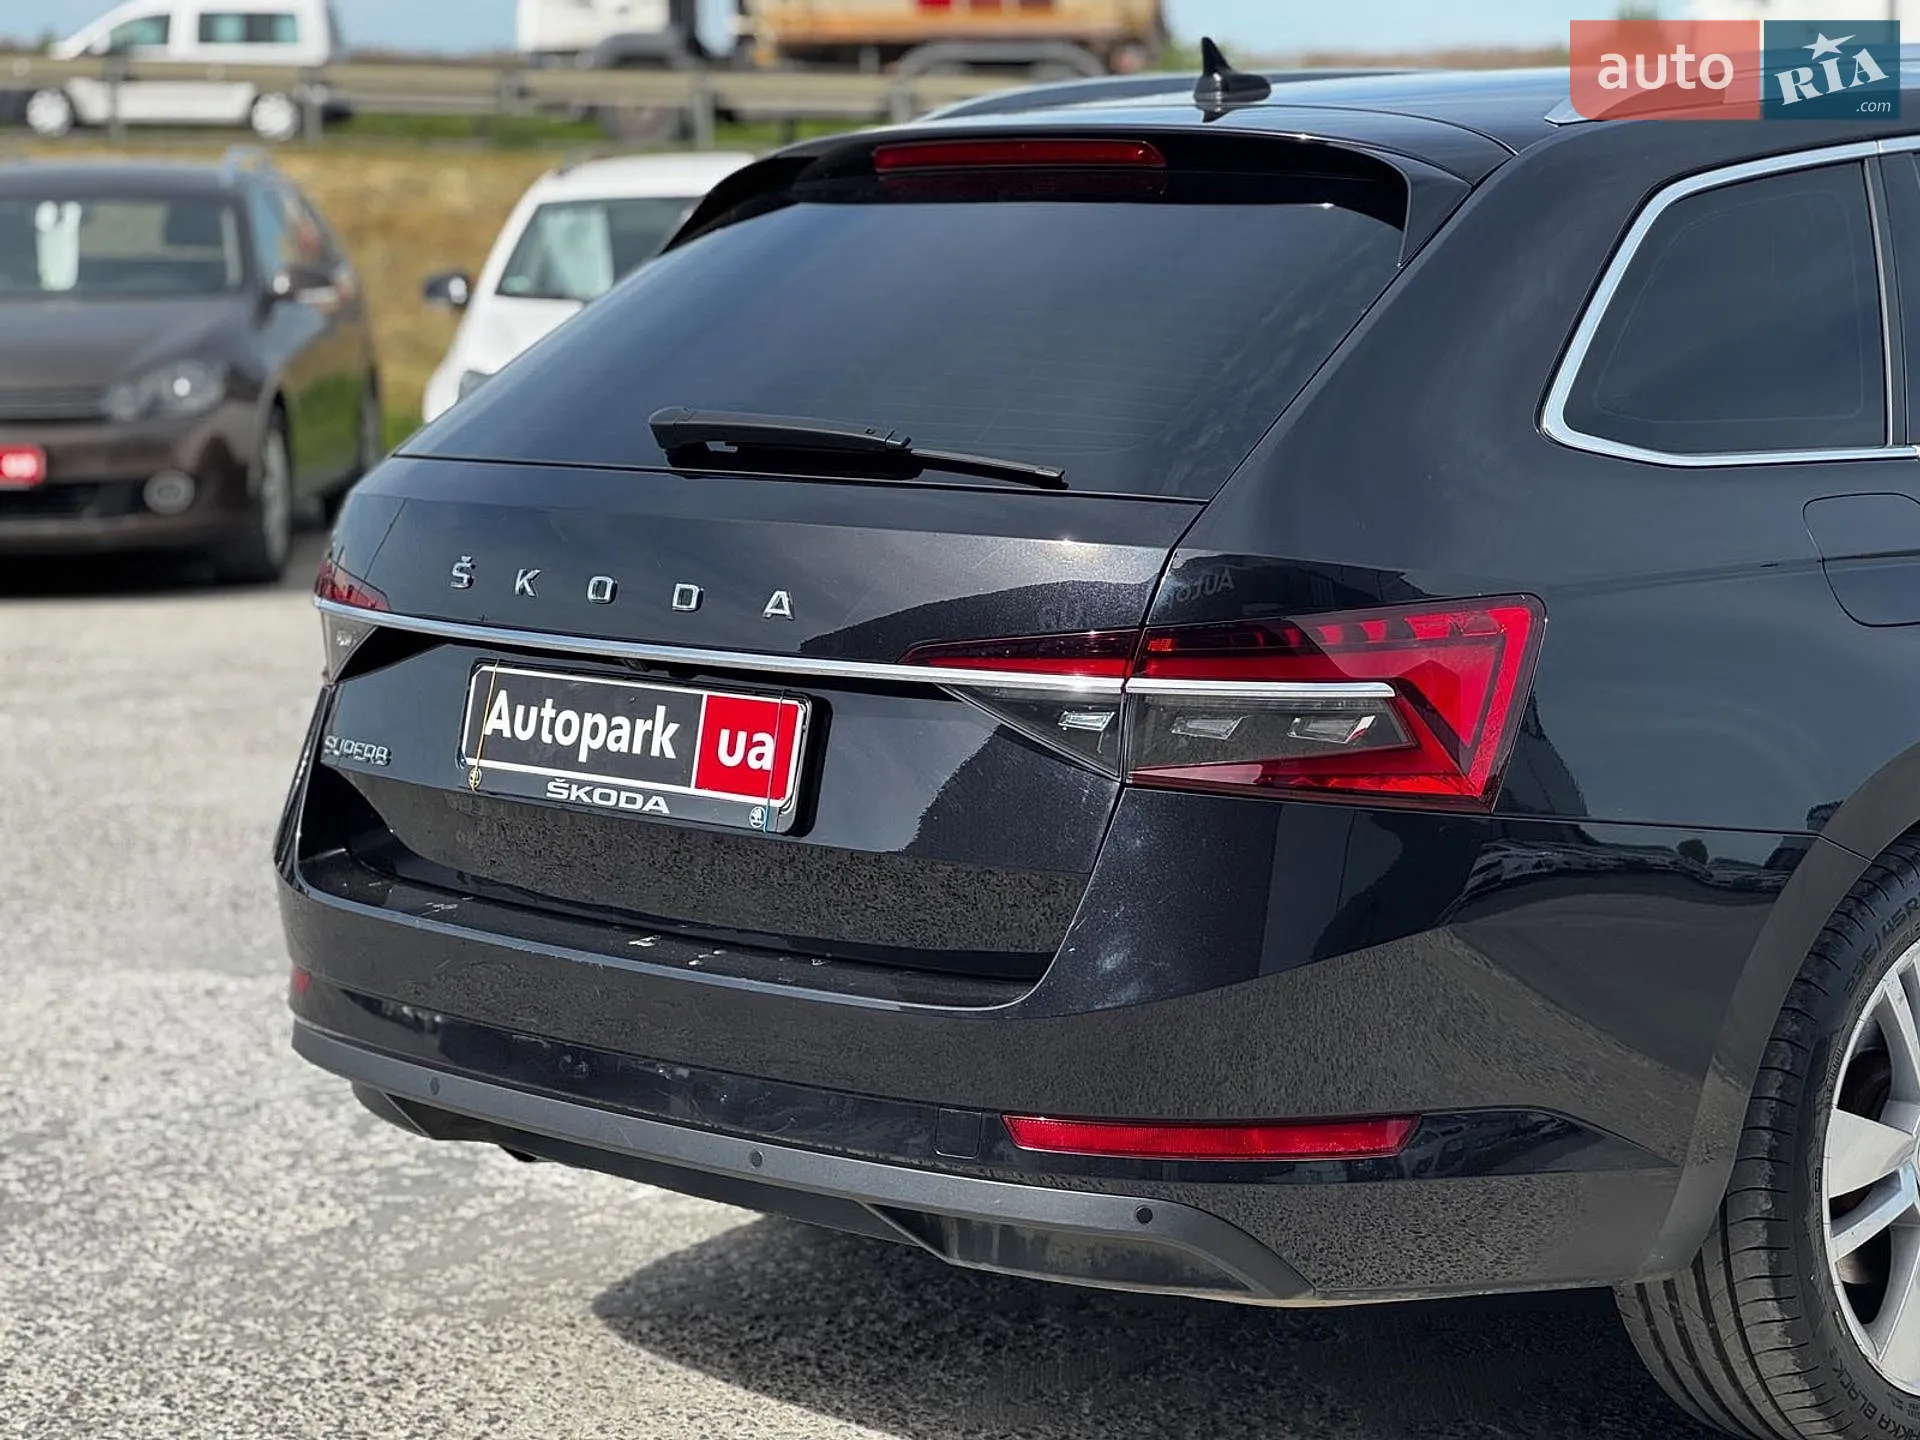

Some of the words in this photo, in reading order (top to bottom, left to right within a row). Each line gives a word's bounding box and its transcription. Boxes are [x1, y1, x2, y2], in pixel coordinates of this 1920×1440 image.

[451, 555, 795, 621] ŠKODA
[323, 735, 391, 767] SUPERB
[484, 689, 681, 763] Autopark
[717, 728, 775, 772] ua
[546, 778, 671, 814] ŠKODA
